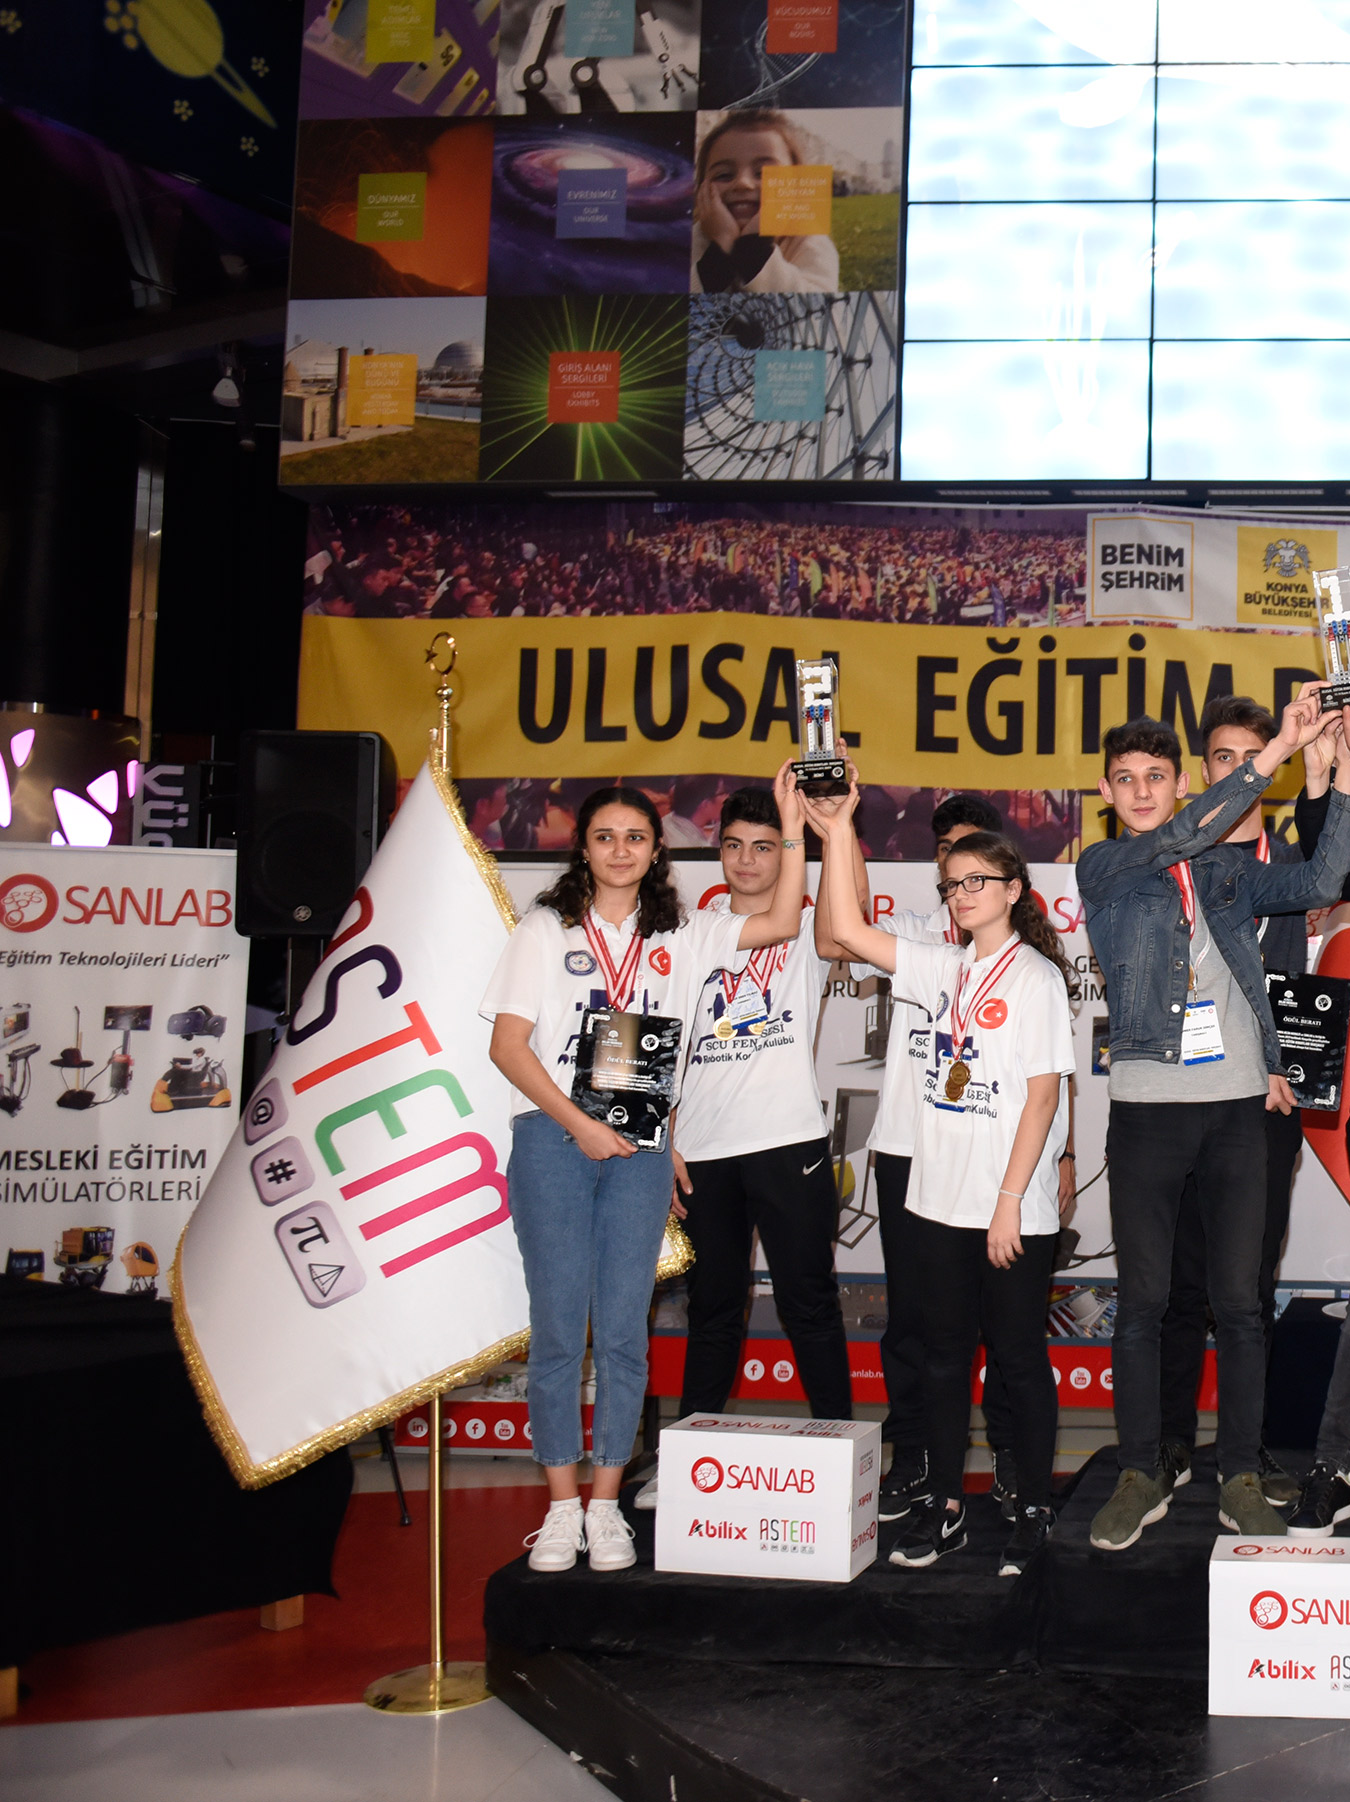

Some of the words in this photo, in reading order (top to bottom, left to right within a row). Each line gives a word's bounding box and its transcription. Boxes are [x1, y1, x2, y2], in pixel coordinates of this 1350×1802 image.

[1101, 543, 1184, 568] BENİM
[1100, 570, 1184, 592] ŞEHRİM
[1266, 582, 1308, 594] KONYA
[1244, 592, 1330, 609] BÜYÜKŞEHR
[1261, 607, 1312, 618] BELEDİYESİ
[915, 632, 1234, 757] EĞİTİM
[62, 884, 233, 928] SANLAB
[59, 950, 168, 970] Teknolojileri
[706, 1041, 728, 1051] SCU
[108, 1143, 207, 1170] EĞİTİM
[720, 1421, 791, 1430] SANLAB
[726, 1464, 815, 1494] SANLAB
[688, 1518, 748, 1541] Abilix
[759, 1518, 815, 1544] ASTEM
[1266, 1546, 1346, 1556] SANLAB
[1247, 1658, 1317, 1680] Abilix
